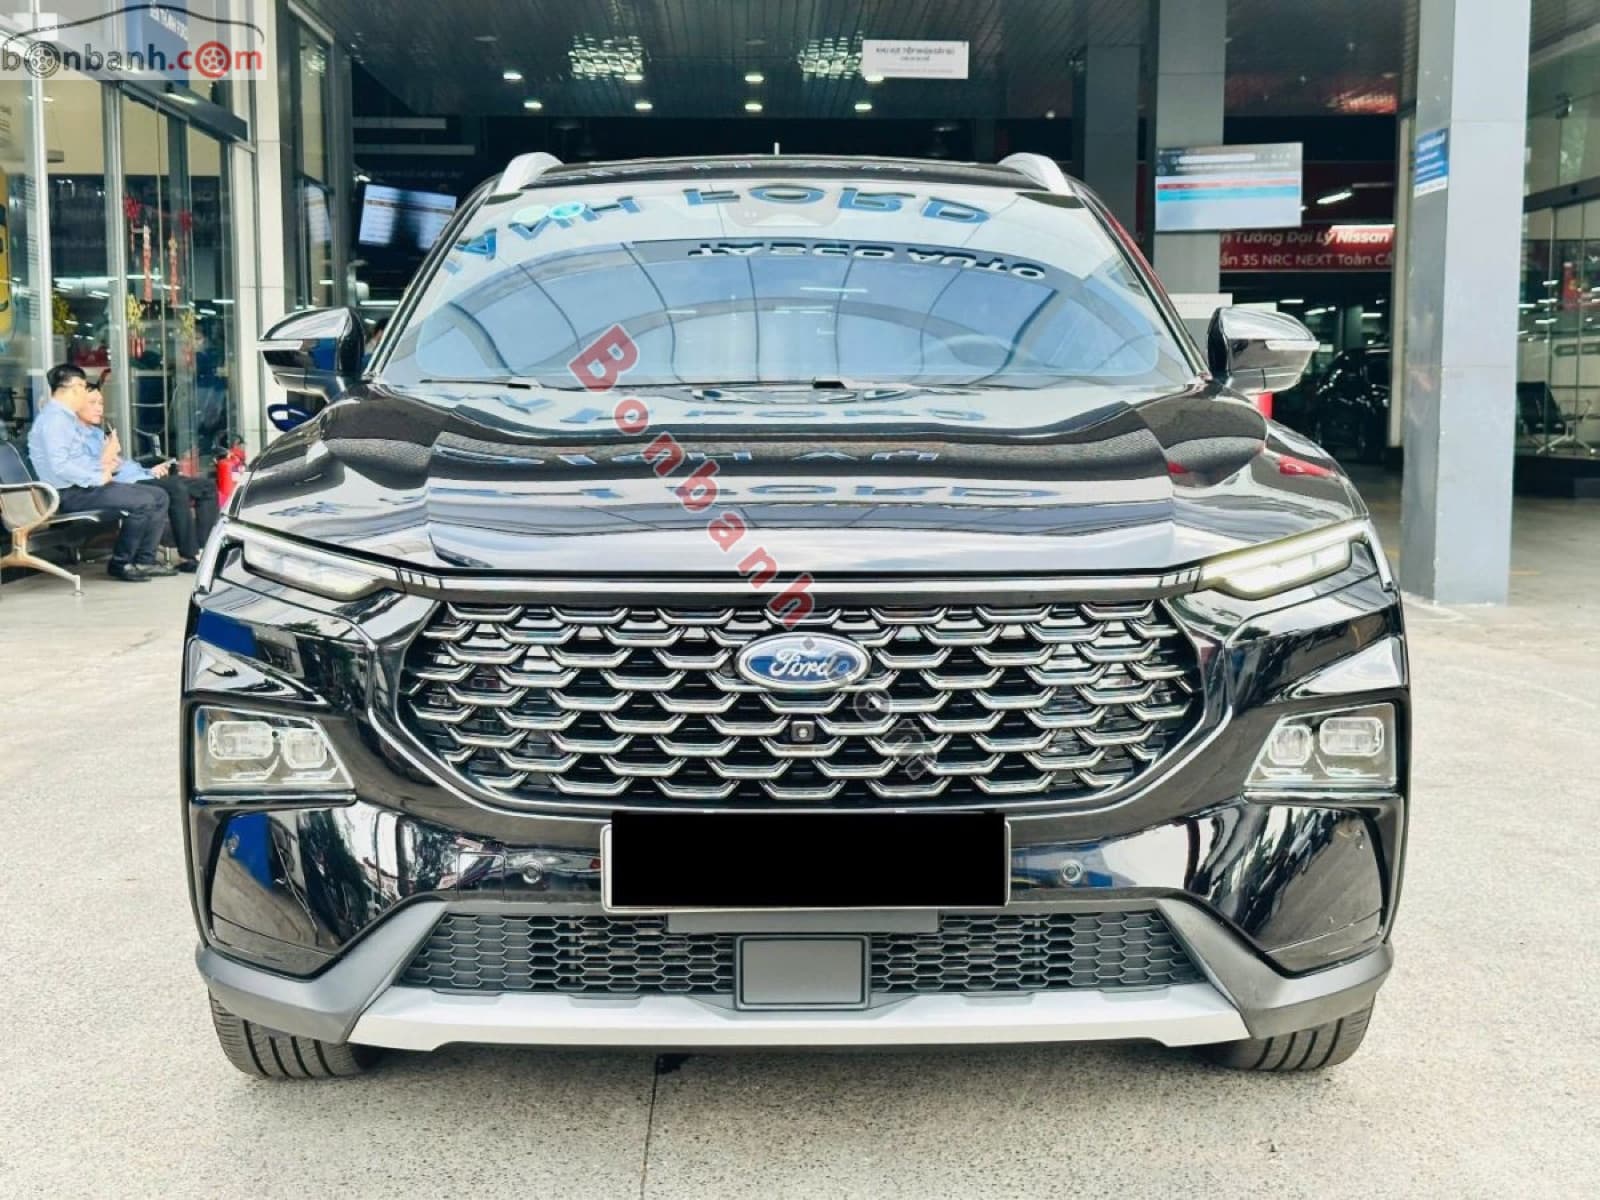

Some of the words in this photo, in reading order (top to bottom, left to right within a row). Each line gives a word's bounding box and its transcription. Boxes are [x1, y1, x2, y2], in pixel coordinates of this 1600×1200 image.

[1336, 229, 1389, 244] Nissan
[1263, 253, 1292, 266] NRC
[1296, 253, 1333, 266] NEXT
[769, 649, 837, 678] Ford
